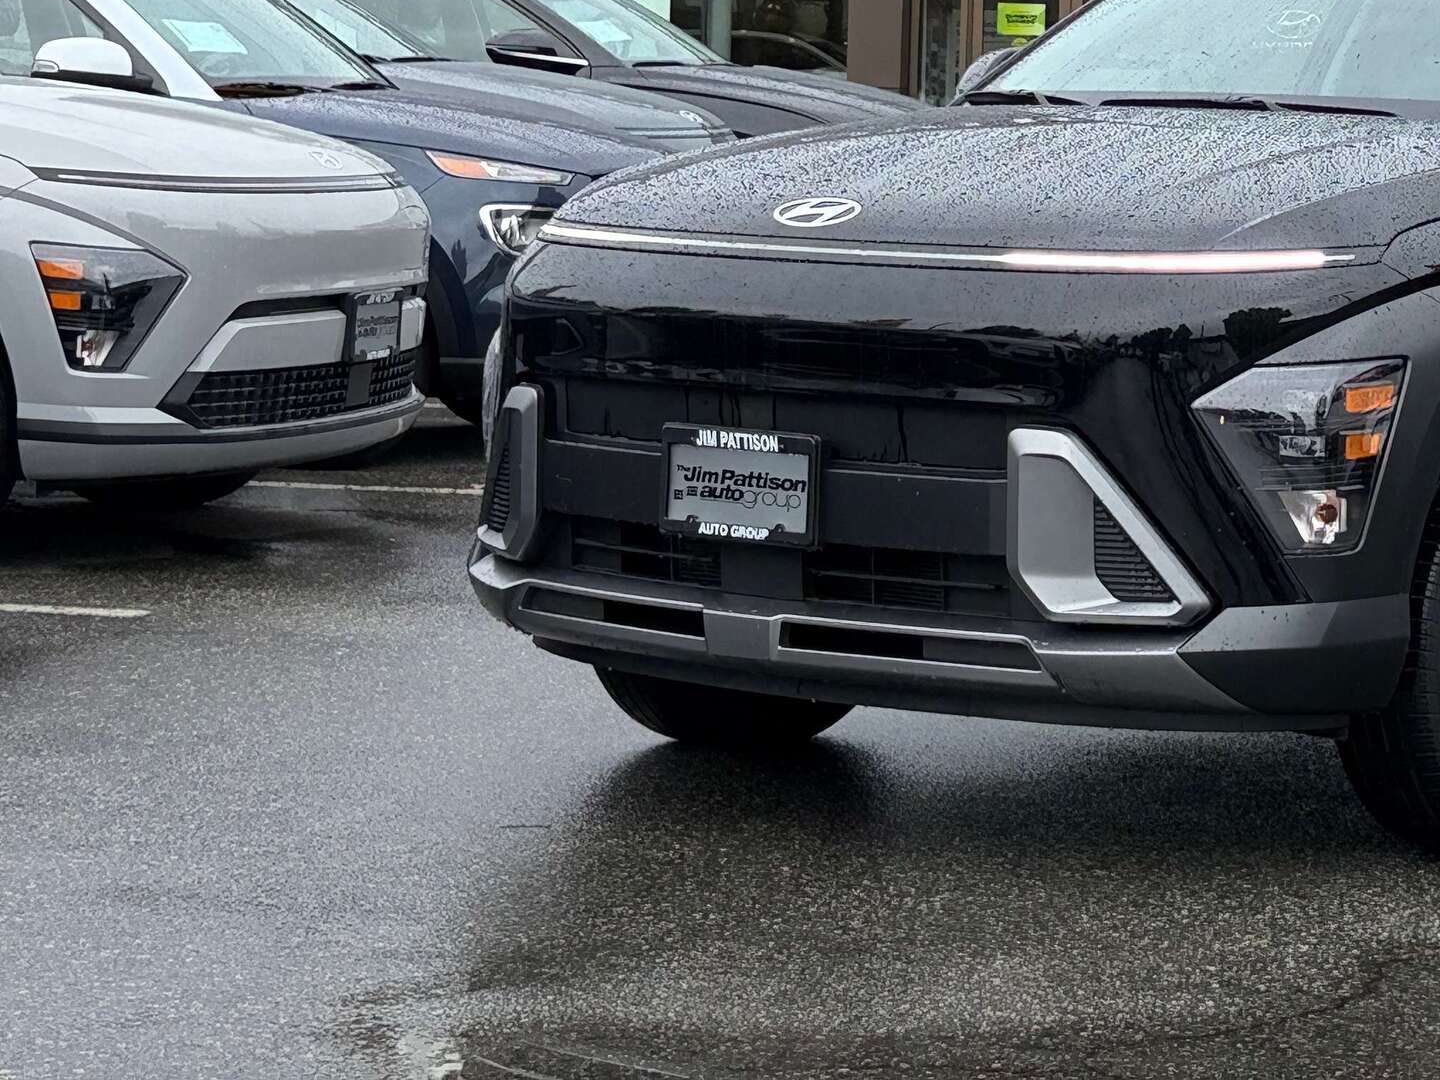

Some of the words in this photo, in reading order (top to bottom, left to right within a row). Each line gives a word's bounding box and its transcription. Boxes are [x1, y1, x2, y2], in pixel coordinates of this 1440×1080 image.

[696, 429, 718, 447] JIM
[720, 431, 779, 453] PATTISON
[698, 522, 729, 537] AUTO
[730, 524, 770, 541] GROUP
